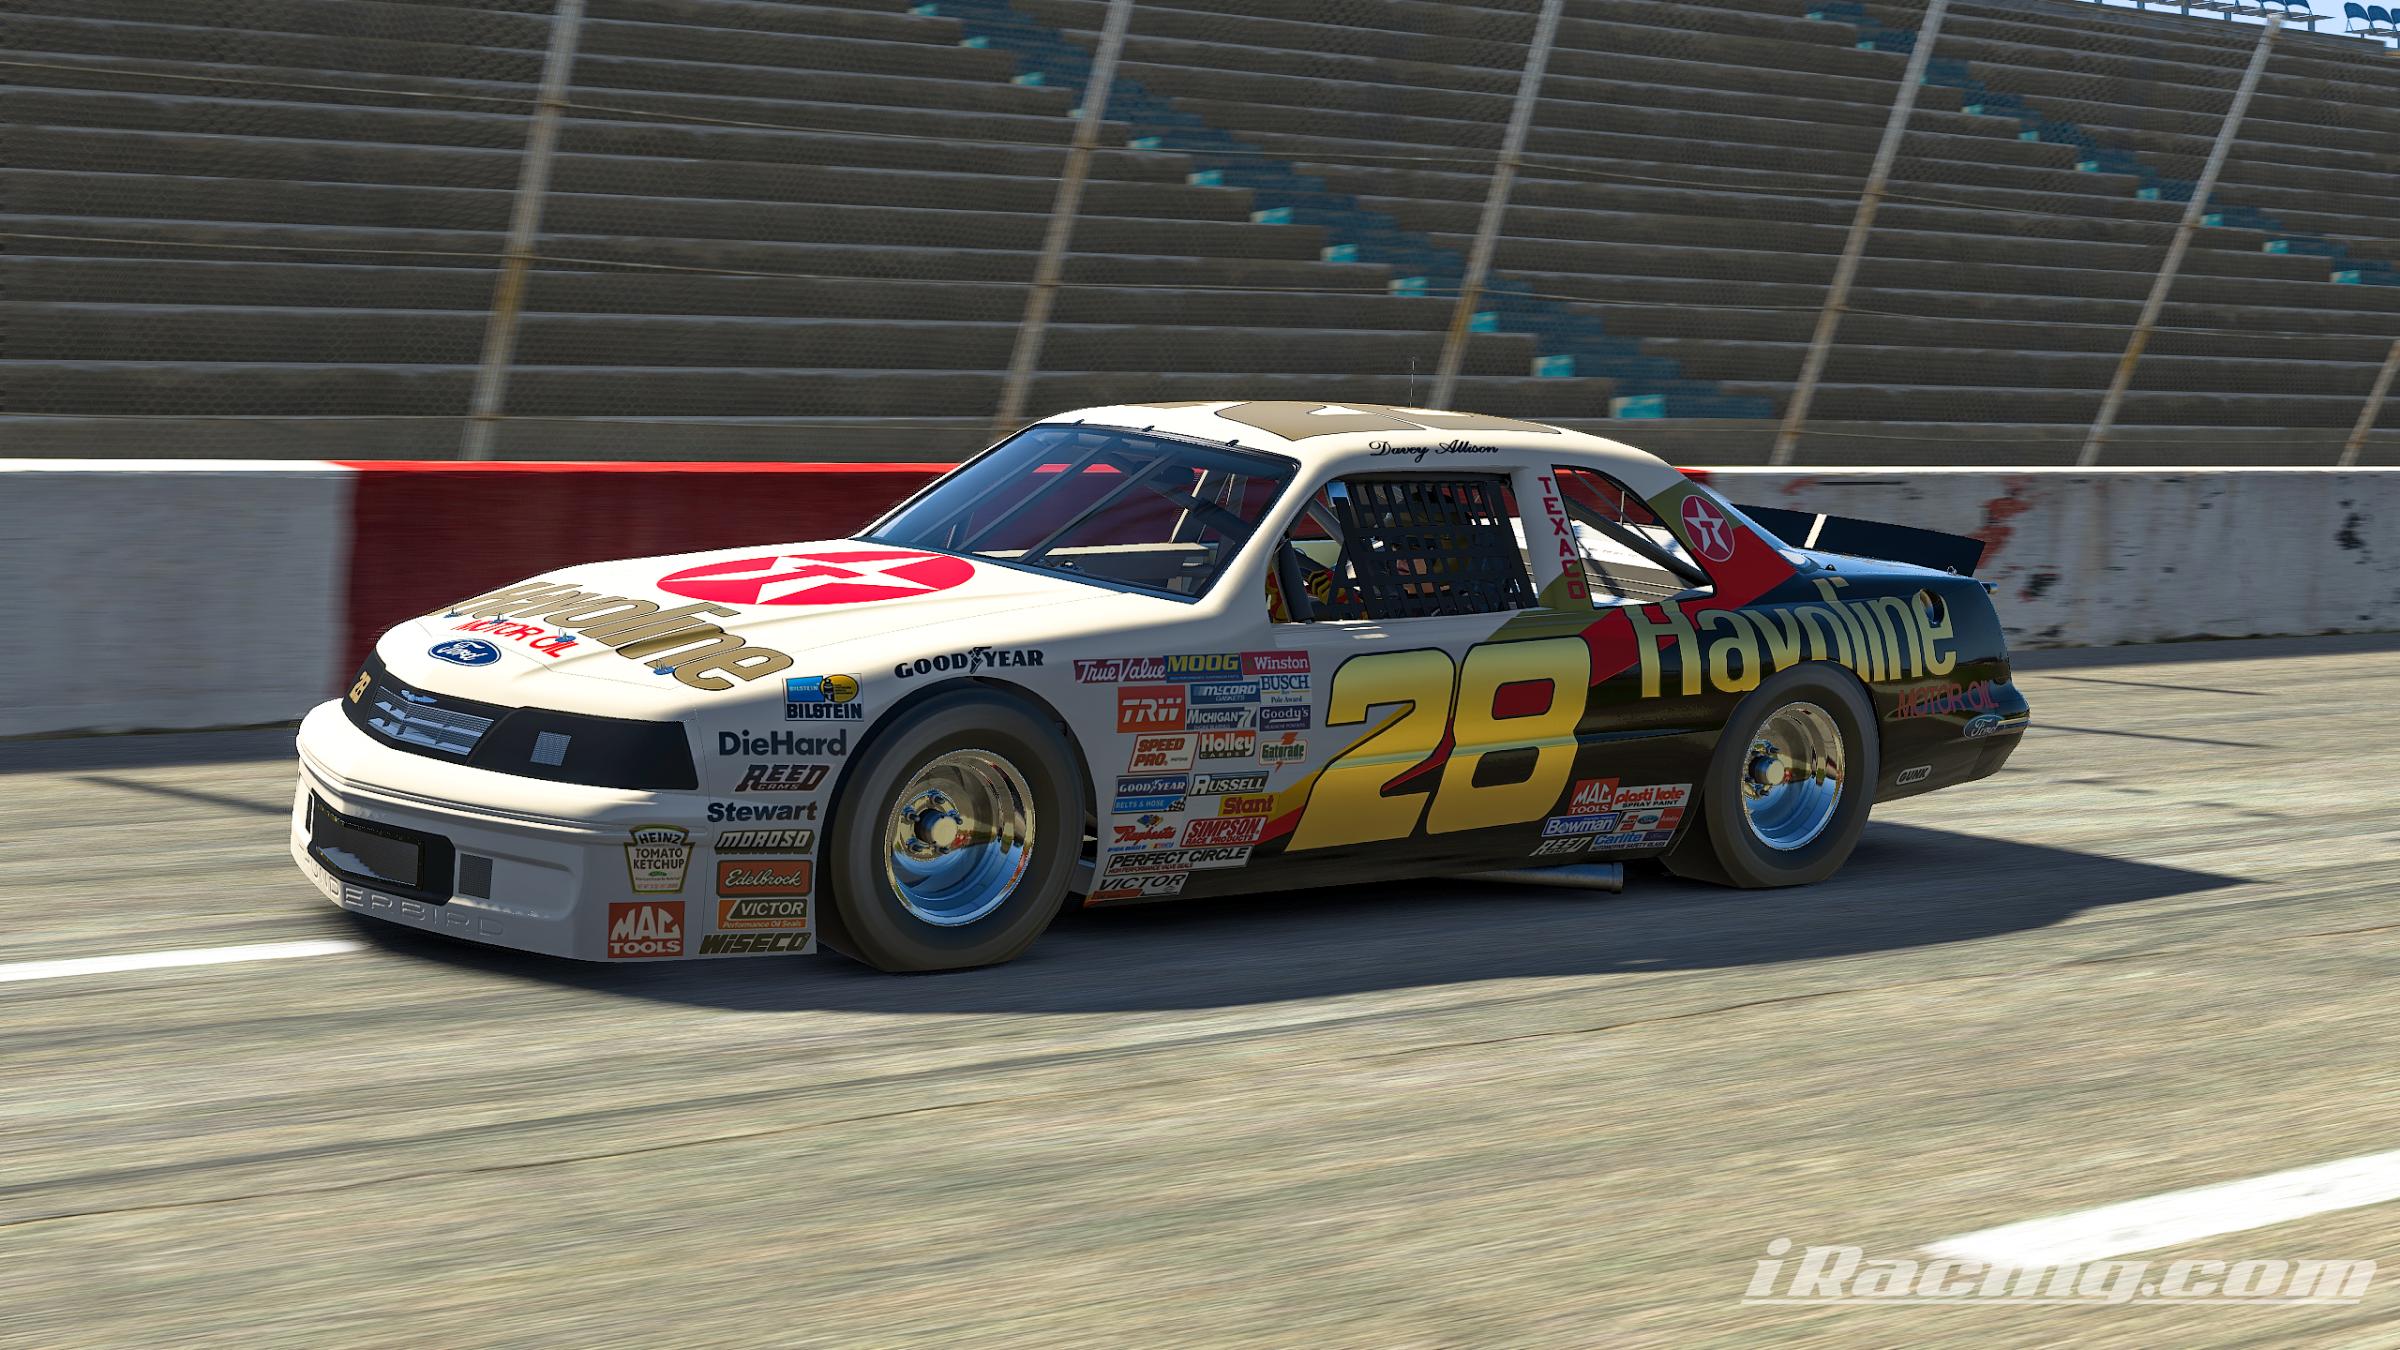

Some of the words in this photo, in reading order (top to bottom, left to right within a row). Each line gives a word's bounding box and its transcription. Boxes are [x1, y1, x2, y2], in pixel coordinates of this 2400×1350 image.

[1368, 440, 1430, 463] Davey
[1434, 439, 1500, 457] Allison
[1537, 476, 1587, 600] TEXACO
[449, 619, 546, 642] MOTOR
[529, 634, 579, 659] OIL
[1625, 576, 1958, 699] Havoline
[437, 641, 489, 662] Ford
[894, 649, 1045, 679] GOODYEAR
[1077, 661, 1117, 683] True
[1106, 658, 1166, 682] Value
[1167, 655, 1240, 673] MOOG
[1254, 656, 1309, 671] Winston
[349, 671, 372, 704] 28
[1261, 675, 1310, 690] BUSCH
[1122, 697, 1182, 723] TRW
[1896, 682, 1967, 721] MOTOR
[1967, 680, 2000, 710] OIL
[786, 703, 862, 719] BILSTEIN
[1236, 706, 1257, 729] 77
[1262, 707, 1309, 723] Goody's
[1970, 718, 1998, 737] Ford
[718, 728, 847, 756] DieHard
[1138, 738, 1185, 752] SPEED
[1201, 732, 1255, 757] Holley
[1262, 743, 1305, 759] Gatorade
[1284, 636, 1592, 853] 28
[734, 763, 832, 792] REED
[1899, 767, 1929, 782] GUNK
[758, 782, 800, 791] CAMS
[1119, 780, 1186, 793] GOODYEAR
[1190, 775, 1265, 796] RUSSELL
[1572, 781, 1612, 806] MAC
[1115, 801, 1137, 809] BELTS
[1222, 795, 1275, 815] Stant
[1613, 788, 1651, 806] plasti
[1655, 786, 1685, 801] kote
[1622, 800, 1652, 808] SPRAY
[707, 801, 818, 823] Stewart
[1570, 804, 1609, 814] TOOLS
[1548, 818, 1613, 835] Bowman
[638, 831, 682, 845] HEINZ
[715, 830, 814, 854] MOROSO
[1186, 838, 1206, 846] RACE
[1210, 834, 1254, 844] PRODUCTS
[1528, 836, 1594, 857] REED
[1594, 832, 1642, 846] Carlite
[635, 848, 683, 859] TOMATO
[1109, 851, 1188, 869] PERFECT
[1188, 846, 1250, 862] CIRCLE
[633, 858, 685, 870] KETCHUP
[724, 868, 802, 888] Edelbrock
[1099, 874, 1187, 890] VICTOR
[740, 901, 805, 916] VICTOR
[610, 905, 681, 940] MAC
[722, 920, 769, 929] Performance
[771, 920, 782, 928] Oil
[782, 919, 802, 927] Seals
[609, 940, 681, 955] TOOLS
